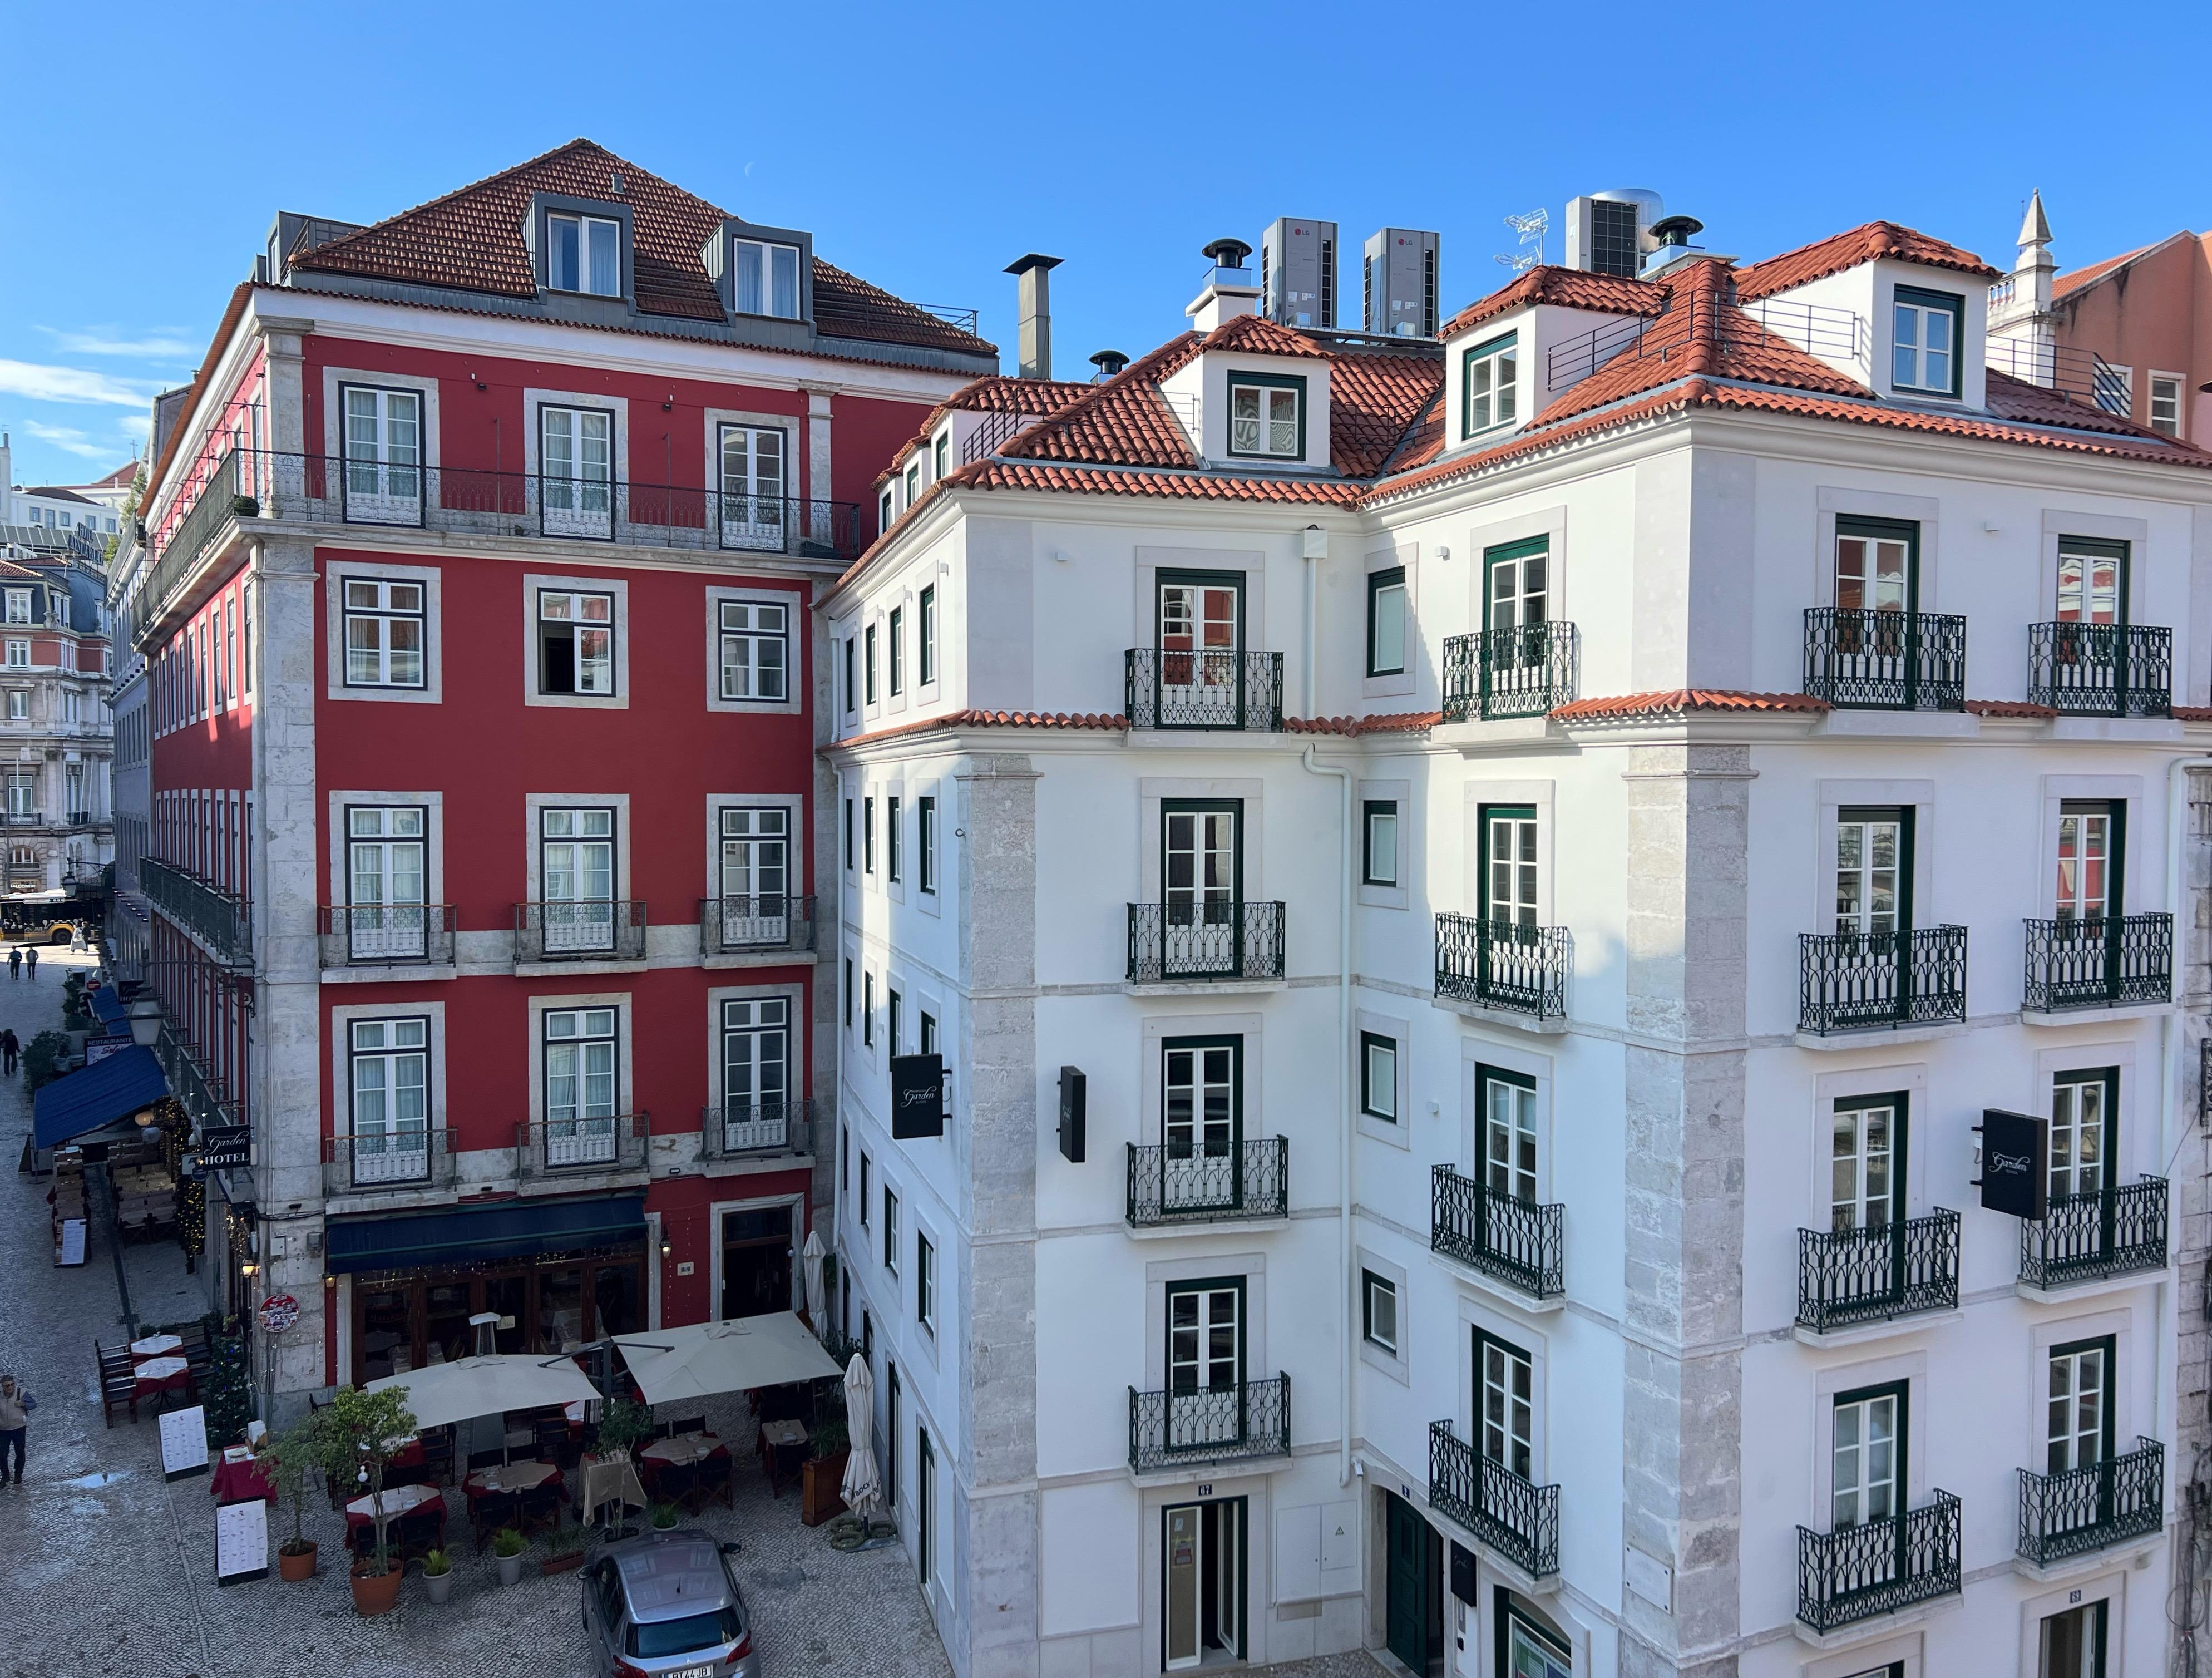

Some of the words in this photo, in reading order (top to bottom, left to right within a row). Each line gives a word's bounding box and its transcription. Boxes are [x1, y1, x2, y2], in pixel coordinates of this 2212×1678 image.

[87, 1037, 133, 1046] RESTAURANTE
[900, 1085, 937, 1108] Garden
[204, 1131, 249, 1156] Garden
[204, 1152, 249, 1166] HOTEL
[1988, 1151, 2031, 1172] Garden
